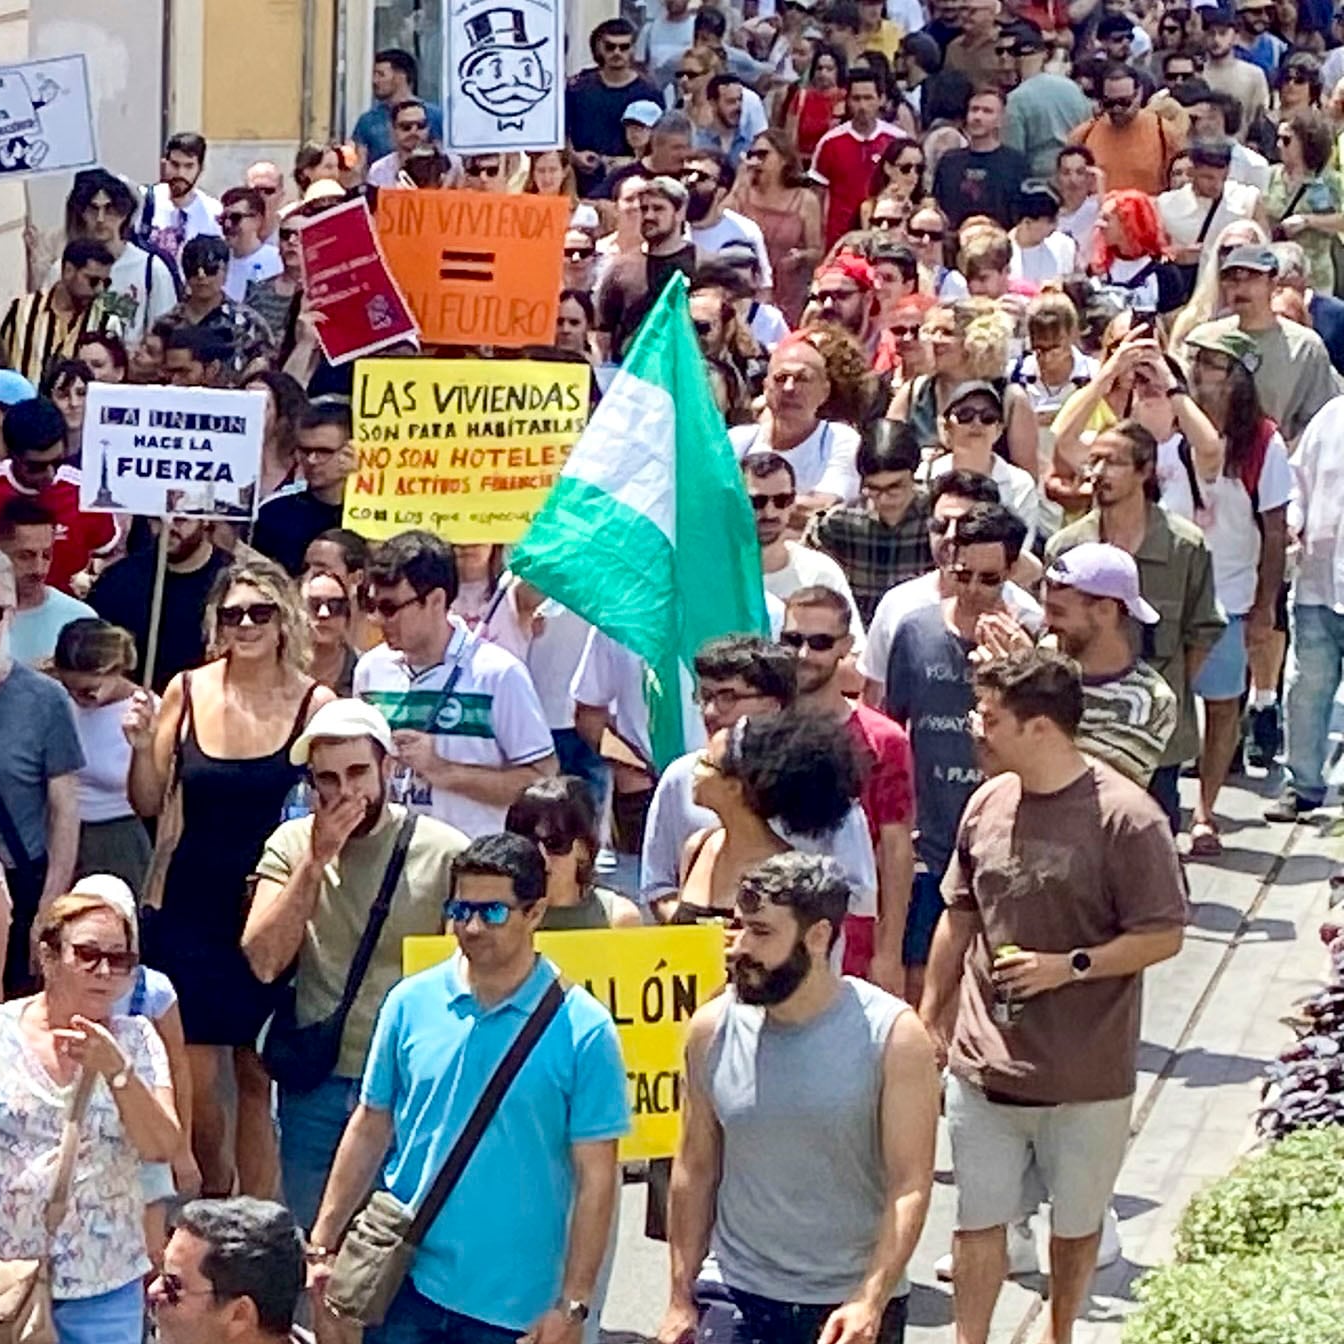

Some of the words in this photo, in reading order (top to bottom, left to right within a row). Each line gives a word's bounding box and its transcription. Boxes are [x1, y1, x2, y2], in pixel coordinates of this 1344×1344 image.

[378, 198, 425, 237] SIN
[437, 201, 556, 240] VIVIENDA
[437, 291, 552, 338] FUTURO
[360, 373, 417, 419] LAS
[431, 381, 582, 416] VIVIENDAS
[100, 405, 141, 427] LA
[133, 434, 185, 451] HACE
[188, 436, 214, 452] LA
[357, 421, 401, 442] SON
[408, 422, 458, 440] PARA
[116, 457, 234, 483] FUERZA
[357, 448, 393, 471] NO
[395, 446, 439, 469] SON
[354, 472, 386, 497] NI
